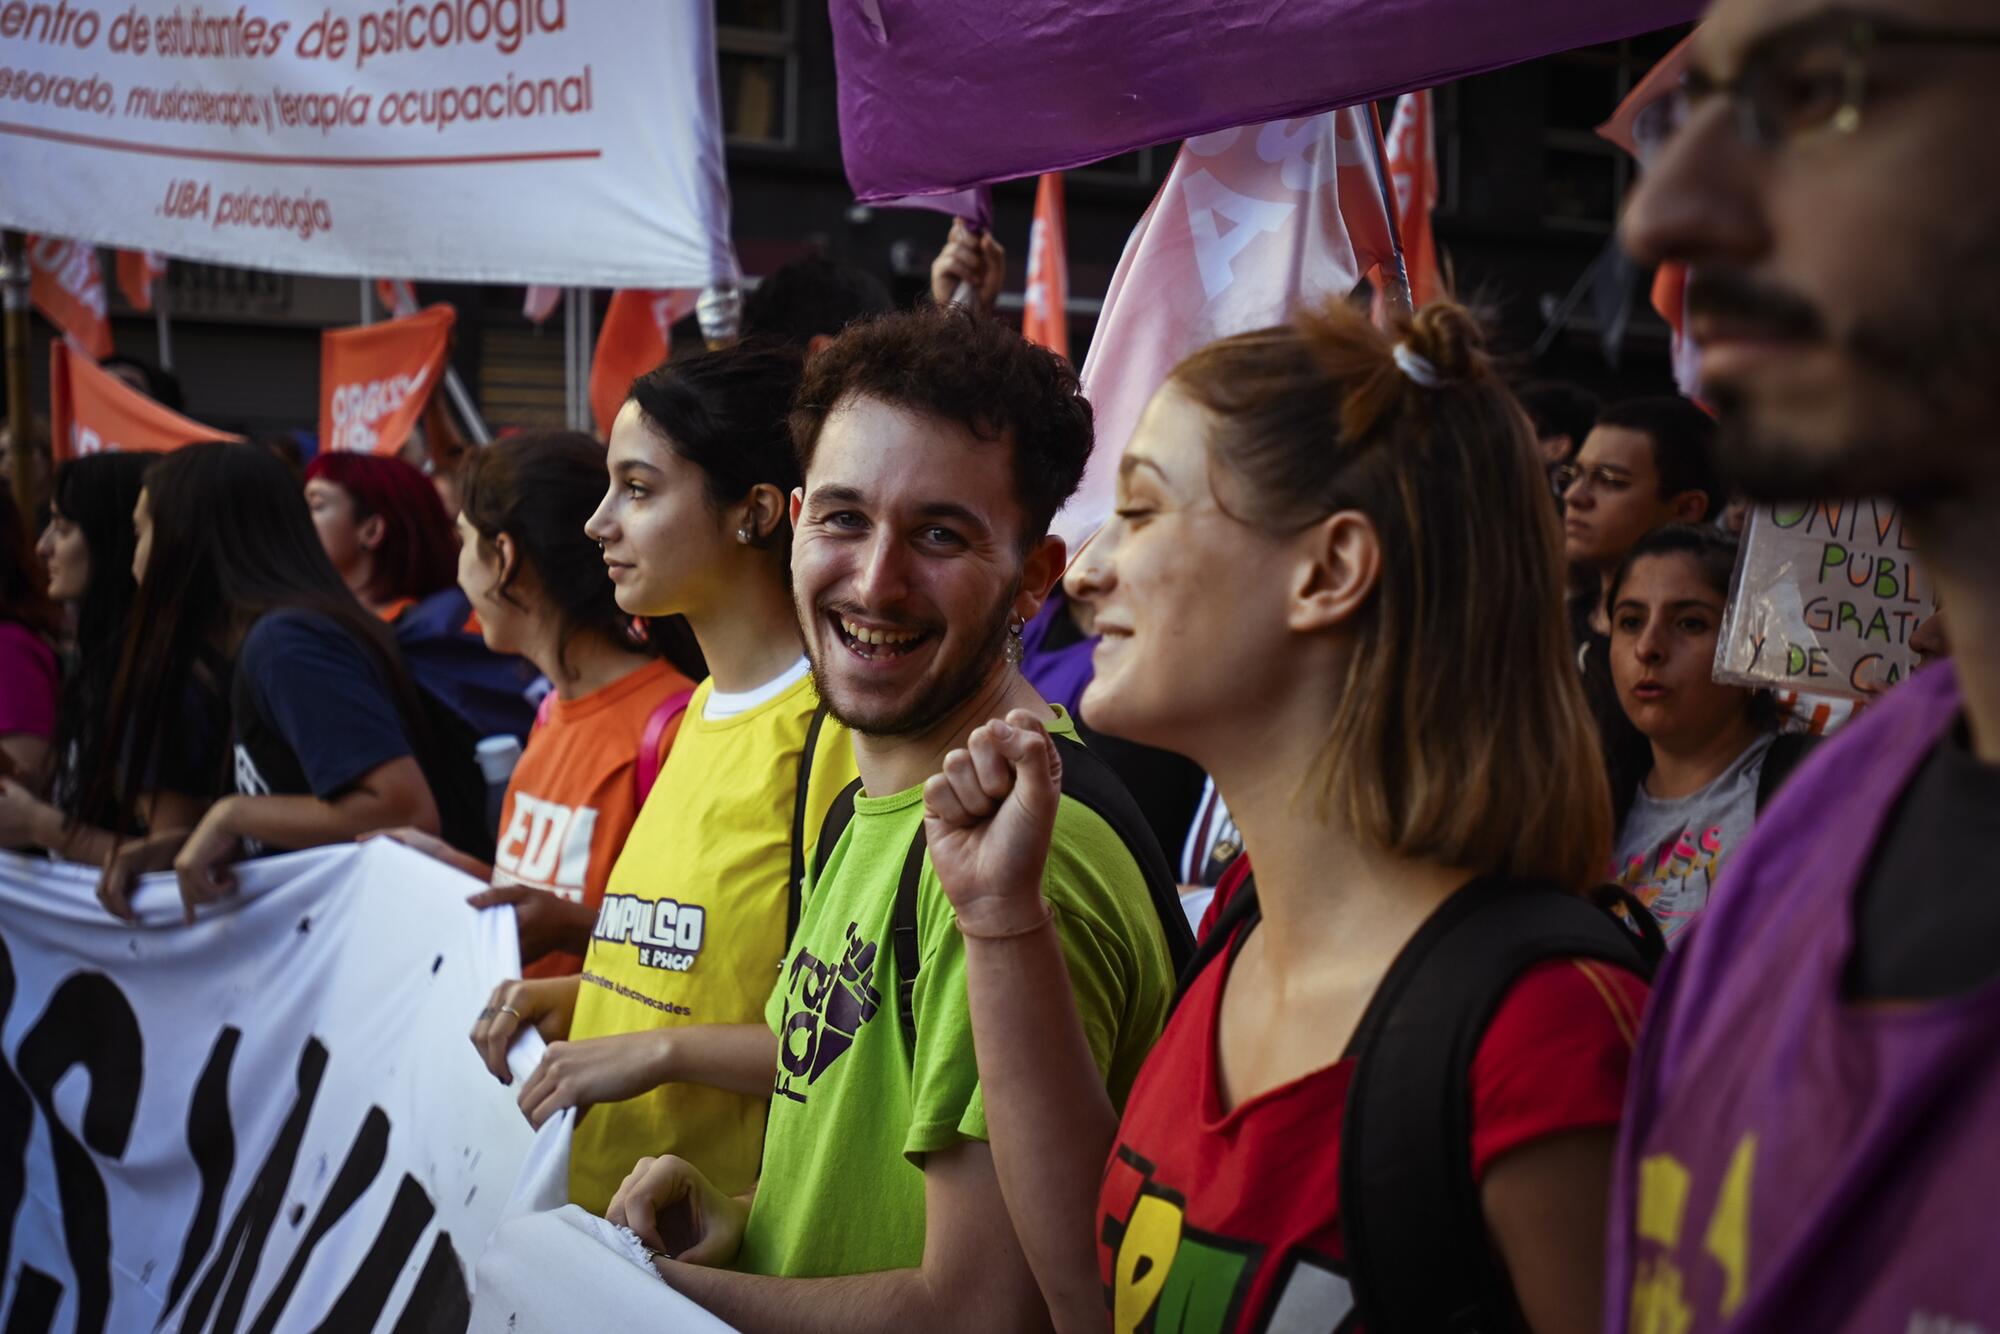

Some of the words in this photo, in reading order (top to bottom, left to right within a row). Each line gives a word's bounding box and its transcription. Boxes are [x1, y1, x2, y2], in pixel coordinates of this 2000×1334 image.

[0, 0, 100, 48] entro
[107, 5, 150, 56] de
[296, 8, 349, 60] de
[378, 64, 593, 132] ocupacional
[1818, 542, 1936, 606] PÚBL
[1786, 642, 1829, 677] DE
[1851, 653, 1916, 693] CA
[495, 789, 599, 886] EDI
[652, 949, 695, 972] PSICO
